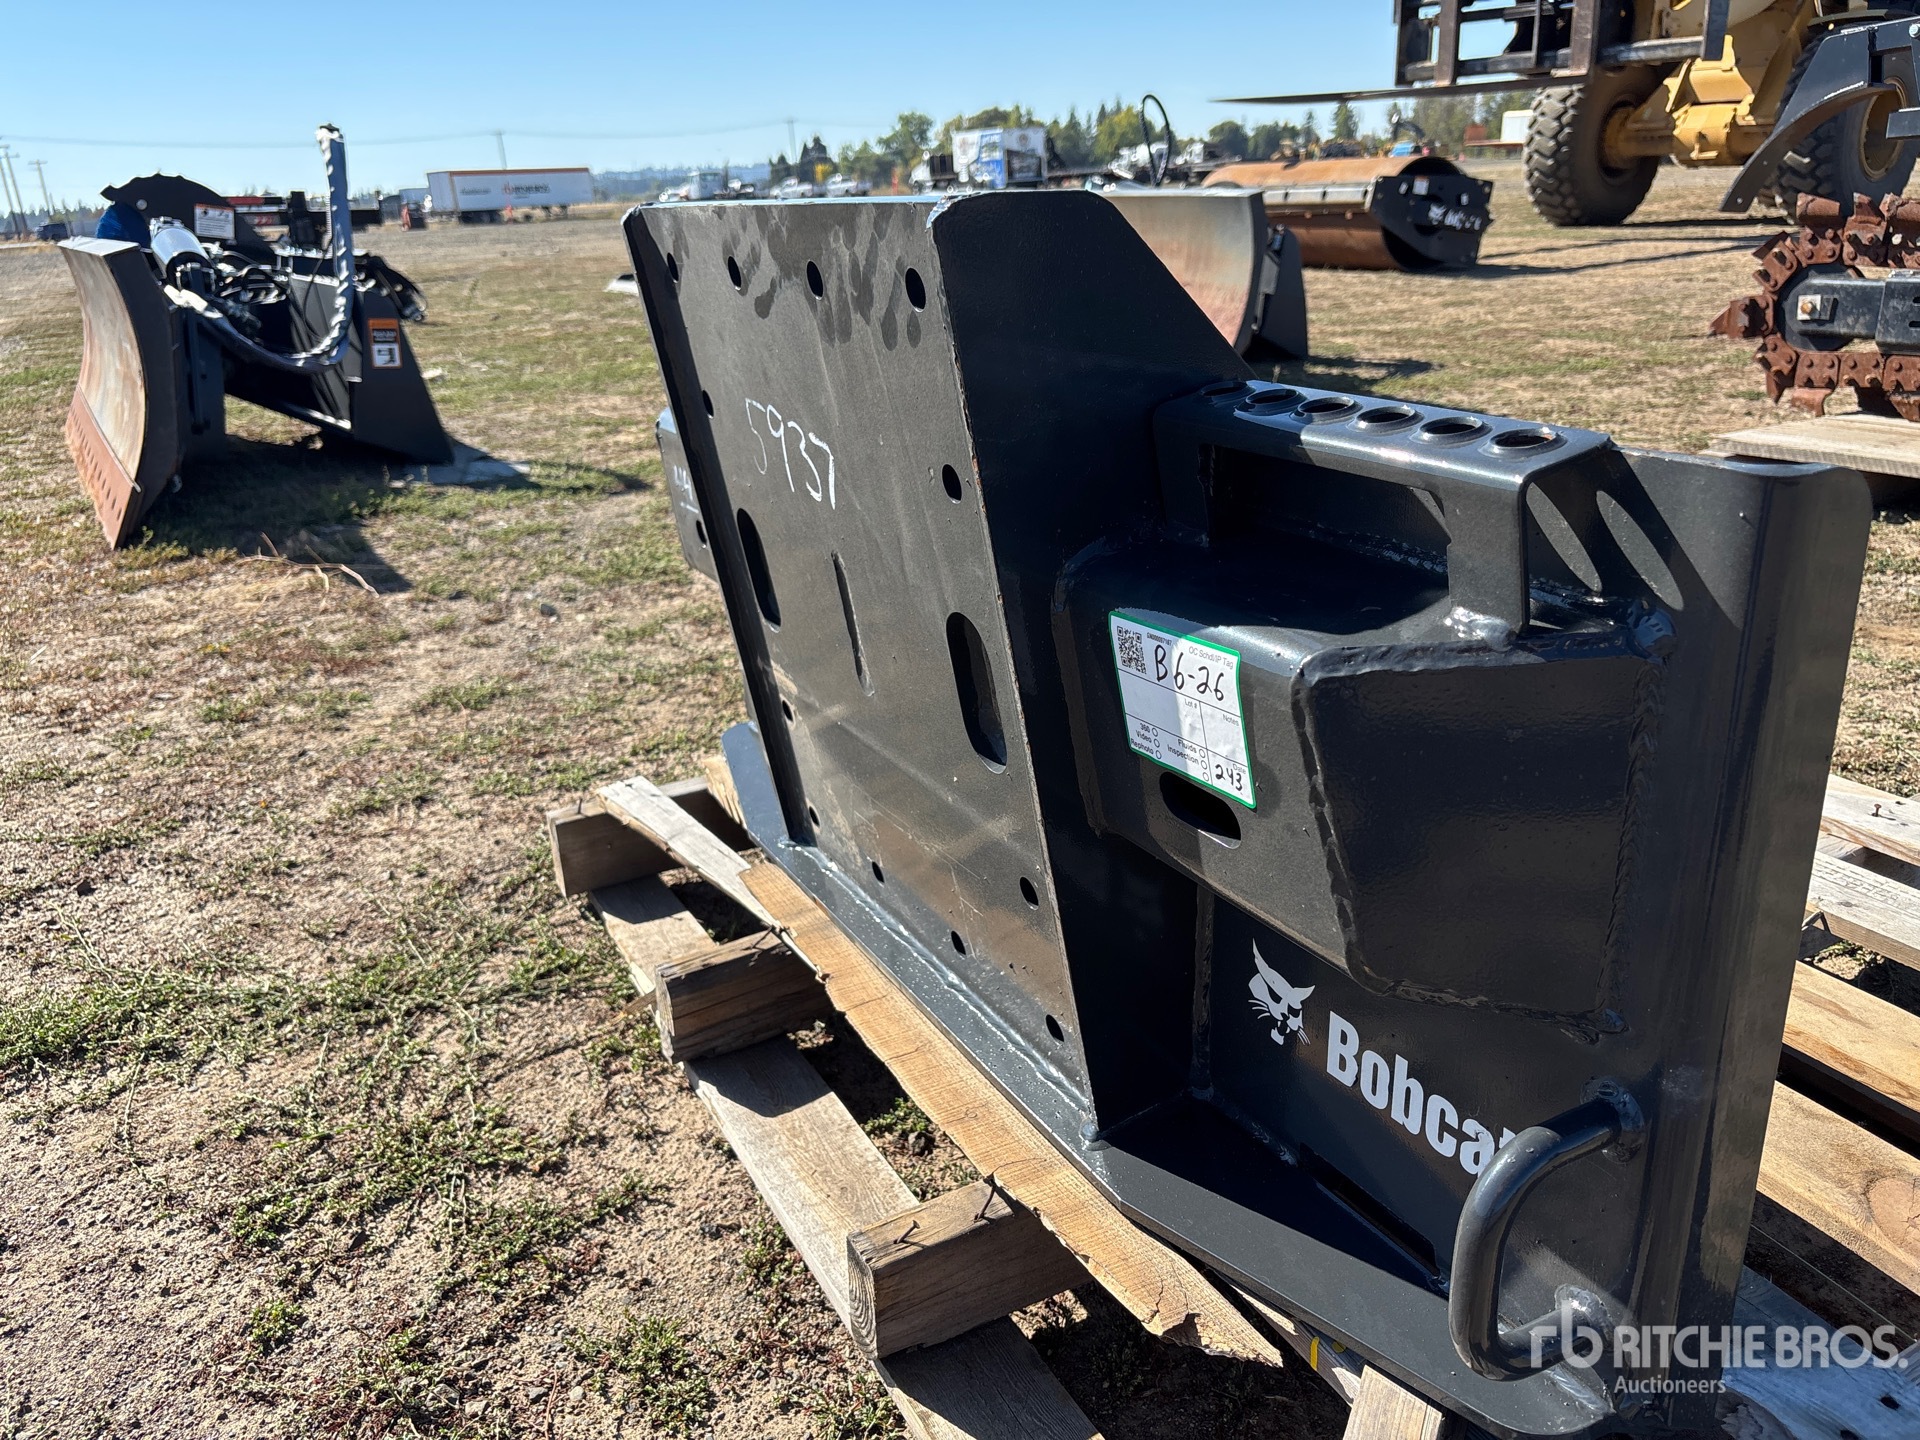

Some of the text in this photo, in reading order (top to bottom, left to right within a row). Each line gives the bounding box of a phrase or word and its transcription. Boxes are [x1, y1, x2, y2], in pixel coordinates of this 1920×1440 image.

[745, 398, 836, 510] 5937
[1188, 645, 1199, 656] OC
[1223, 657, 1234, 670] Tag
[1184, 698, 1193, 708] Lot
[1139, 722, 1151, 734] 360
[1222, 713, 1240, 727] Notes
[1135, 729, 1153, 744] Video
[1130, 737, 1154, 756] Rephoto
[1177, 738, 1197, 754] Fluids
[1167, 744, 1200, 766] Inspection
[1232, 763, 1247, 775] Date
[1215, 763, 1244, 792] 243
